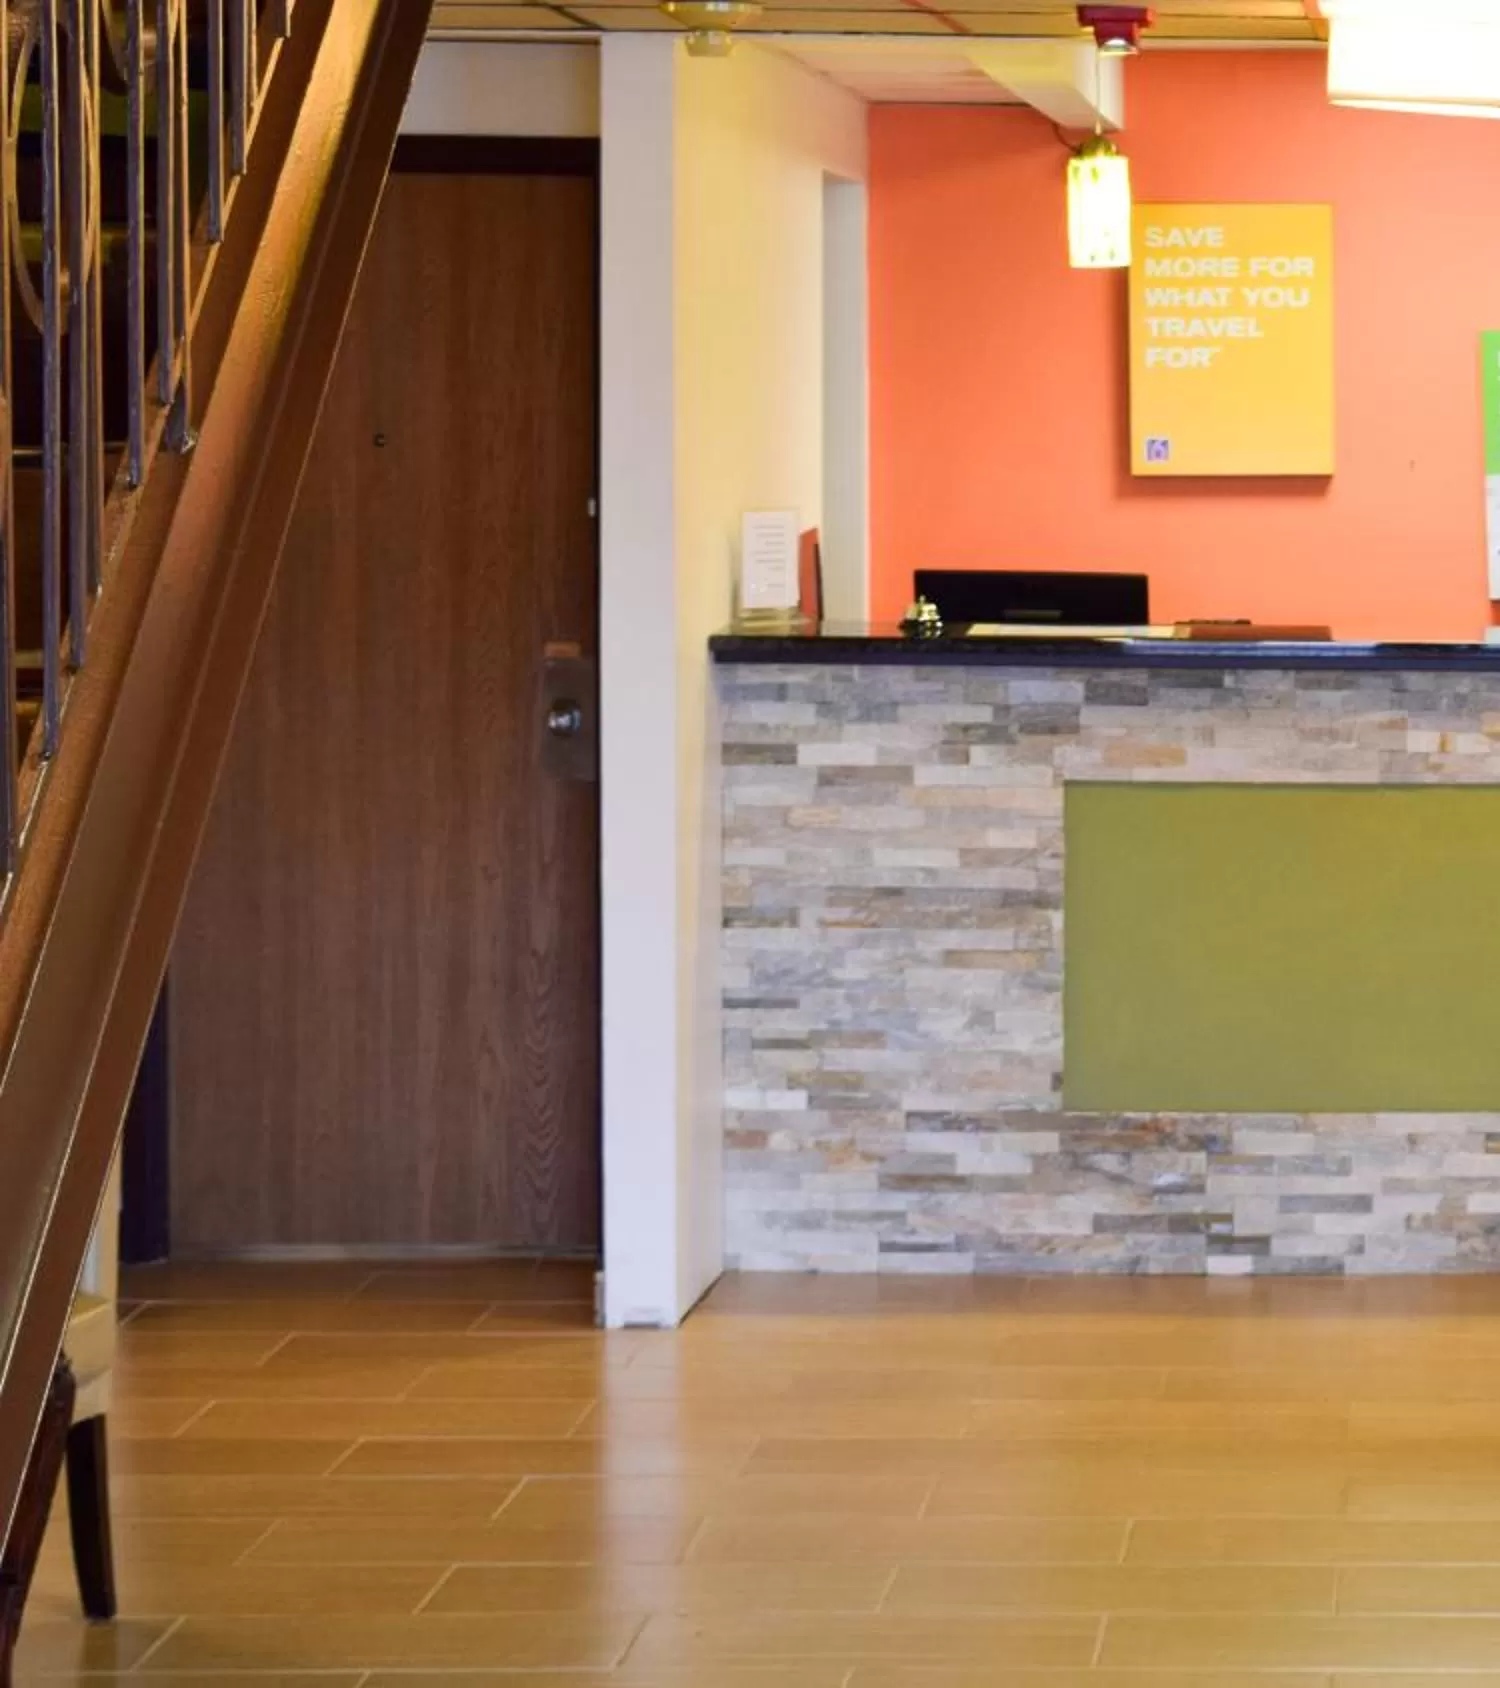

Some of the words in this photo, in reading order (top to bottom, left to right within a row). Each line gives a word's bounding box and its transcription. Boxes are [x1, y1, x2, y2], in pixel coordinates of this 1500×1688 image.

[1145, 226, 1224, 248] SAVE
[1145, 257, 1240, 278] MORE
[1249, 256, 1315, 278] FOR
[1145, 287, 1231, 308] WHAT
[1242, 286, 1310, 308] YOU
[1147, 317, 1264, 338] TRAVEL
